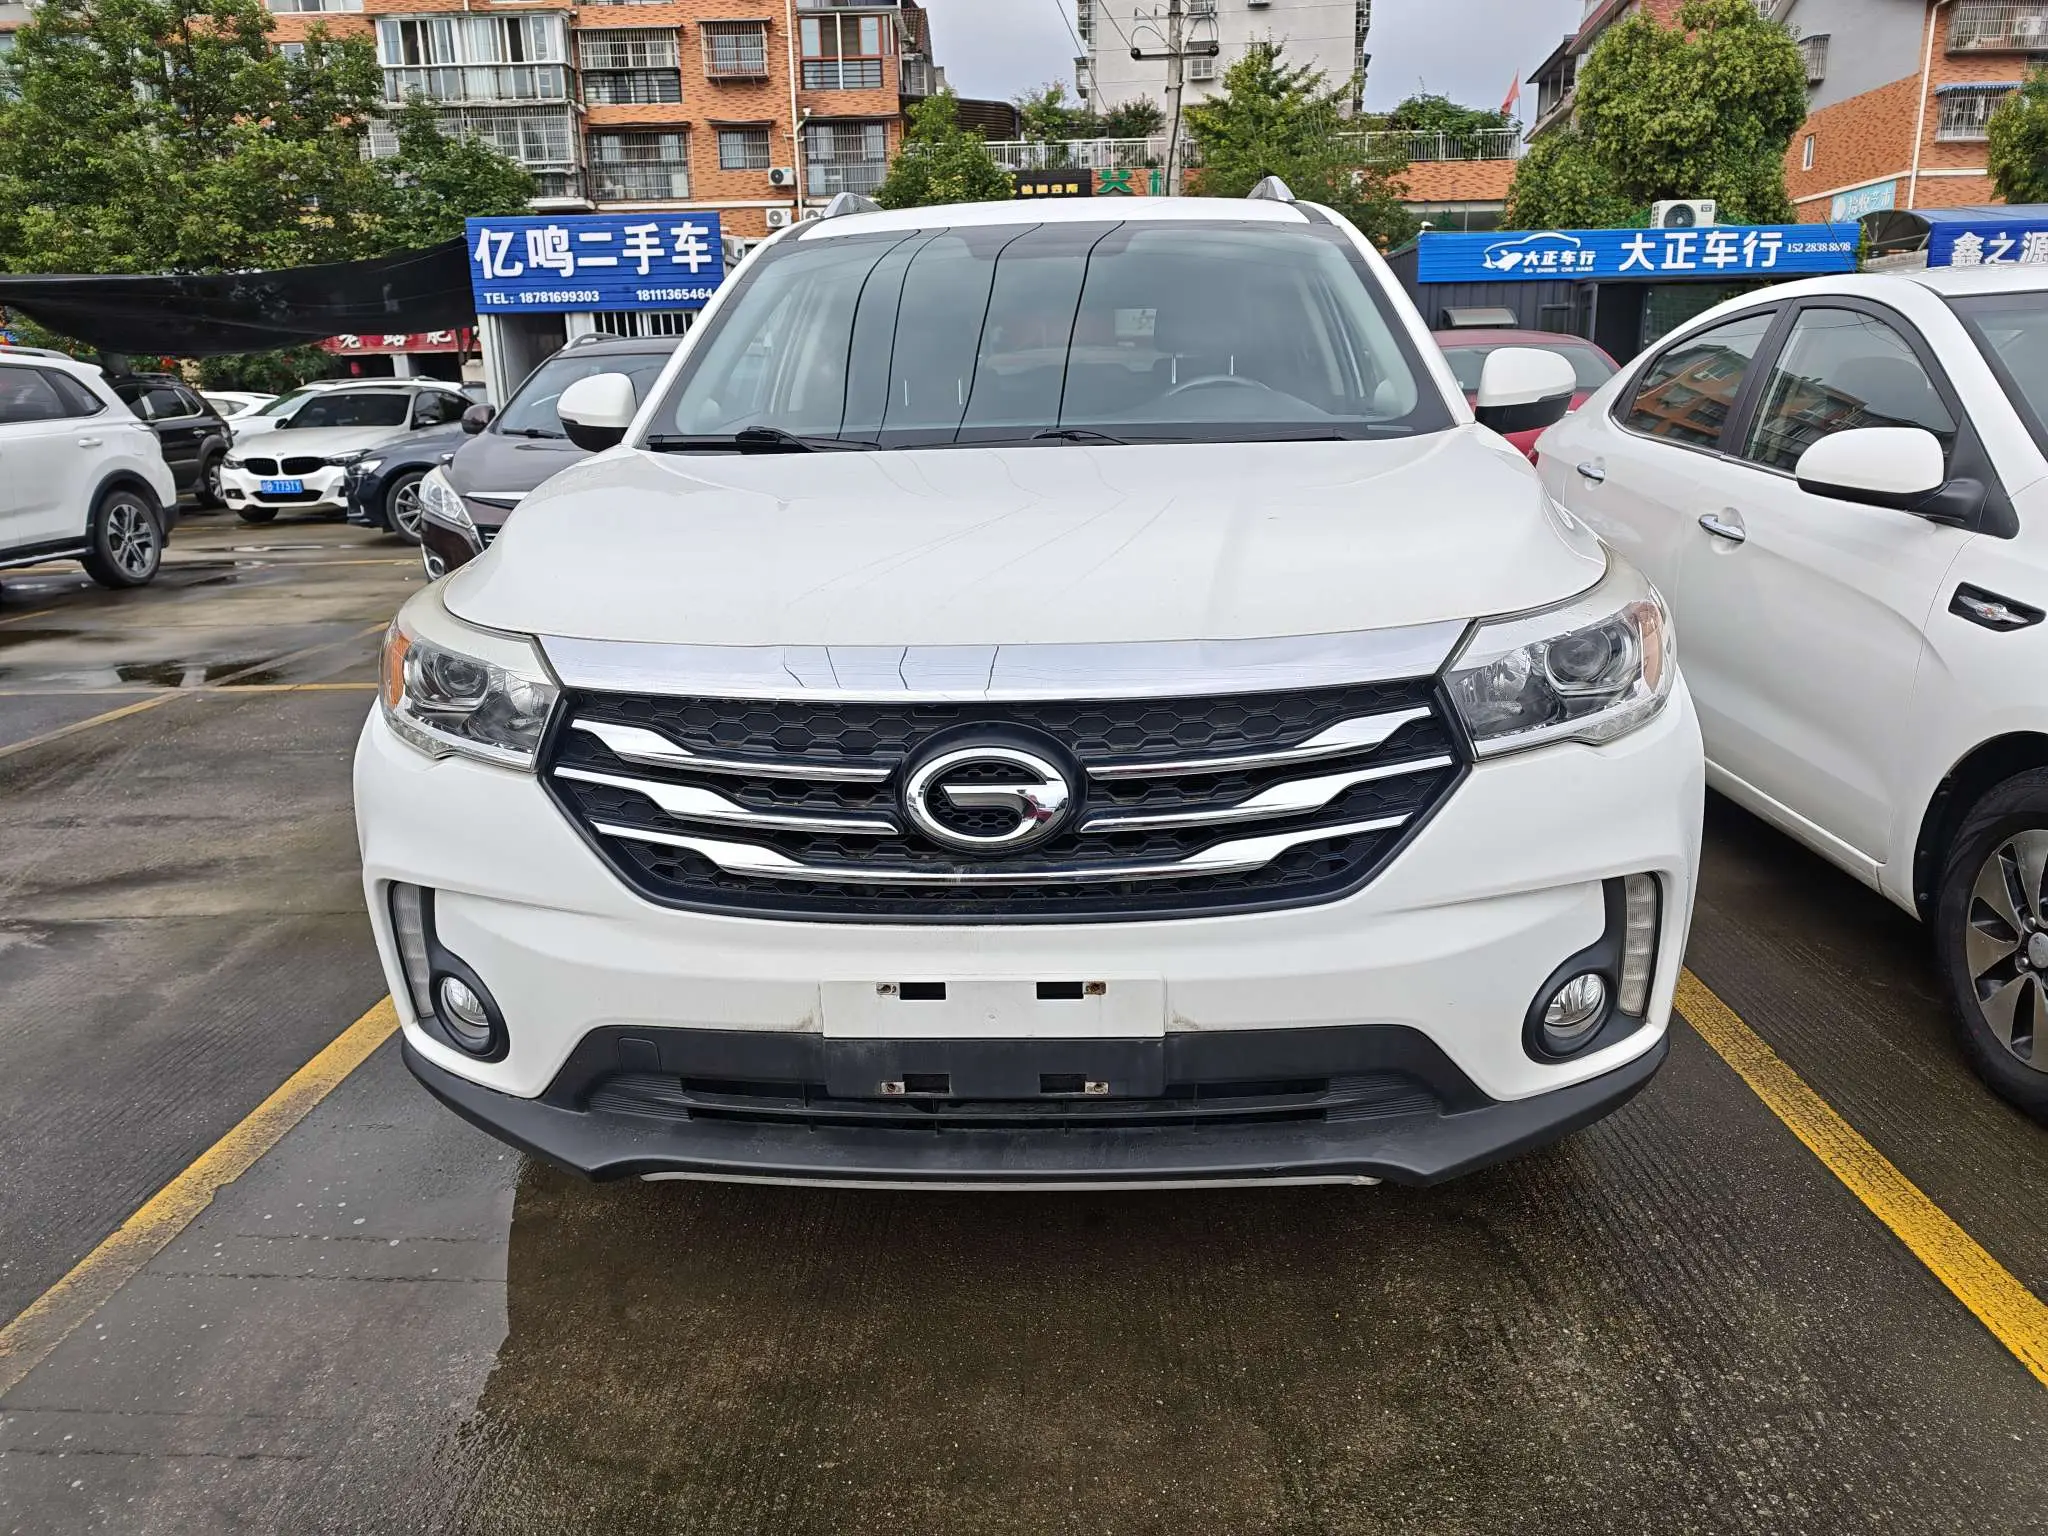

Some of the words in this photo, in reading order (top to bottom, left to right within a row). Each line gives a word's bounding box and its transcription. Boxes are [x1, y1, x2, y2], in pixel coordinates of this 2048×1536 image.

[474, 221, 712, 280] 亿鸣二手车
[1523, 250, 1597, 267] 大正车行
[1619, 231, 1783, 272] 大正车行
[1787, 242, 1804, 254] 152
[1951, 231, 2048, 266] 鑫之源
[519, 290, 600, 304] 18781699303
[636, 287, 714, 302] 18111365464
